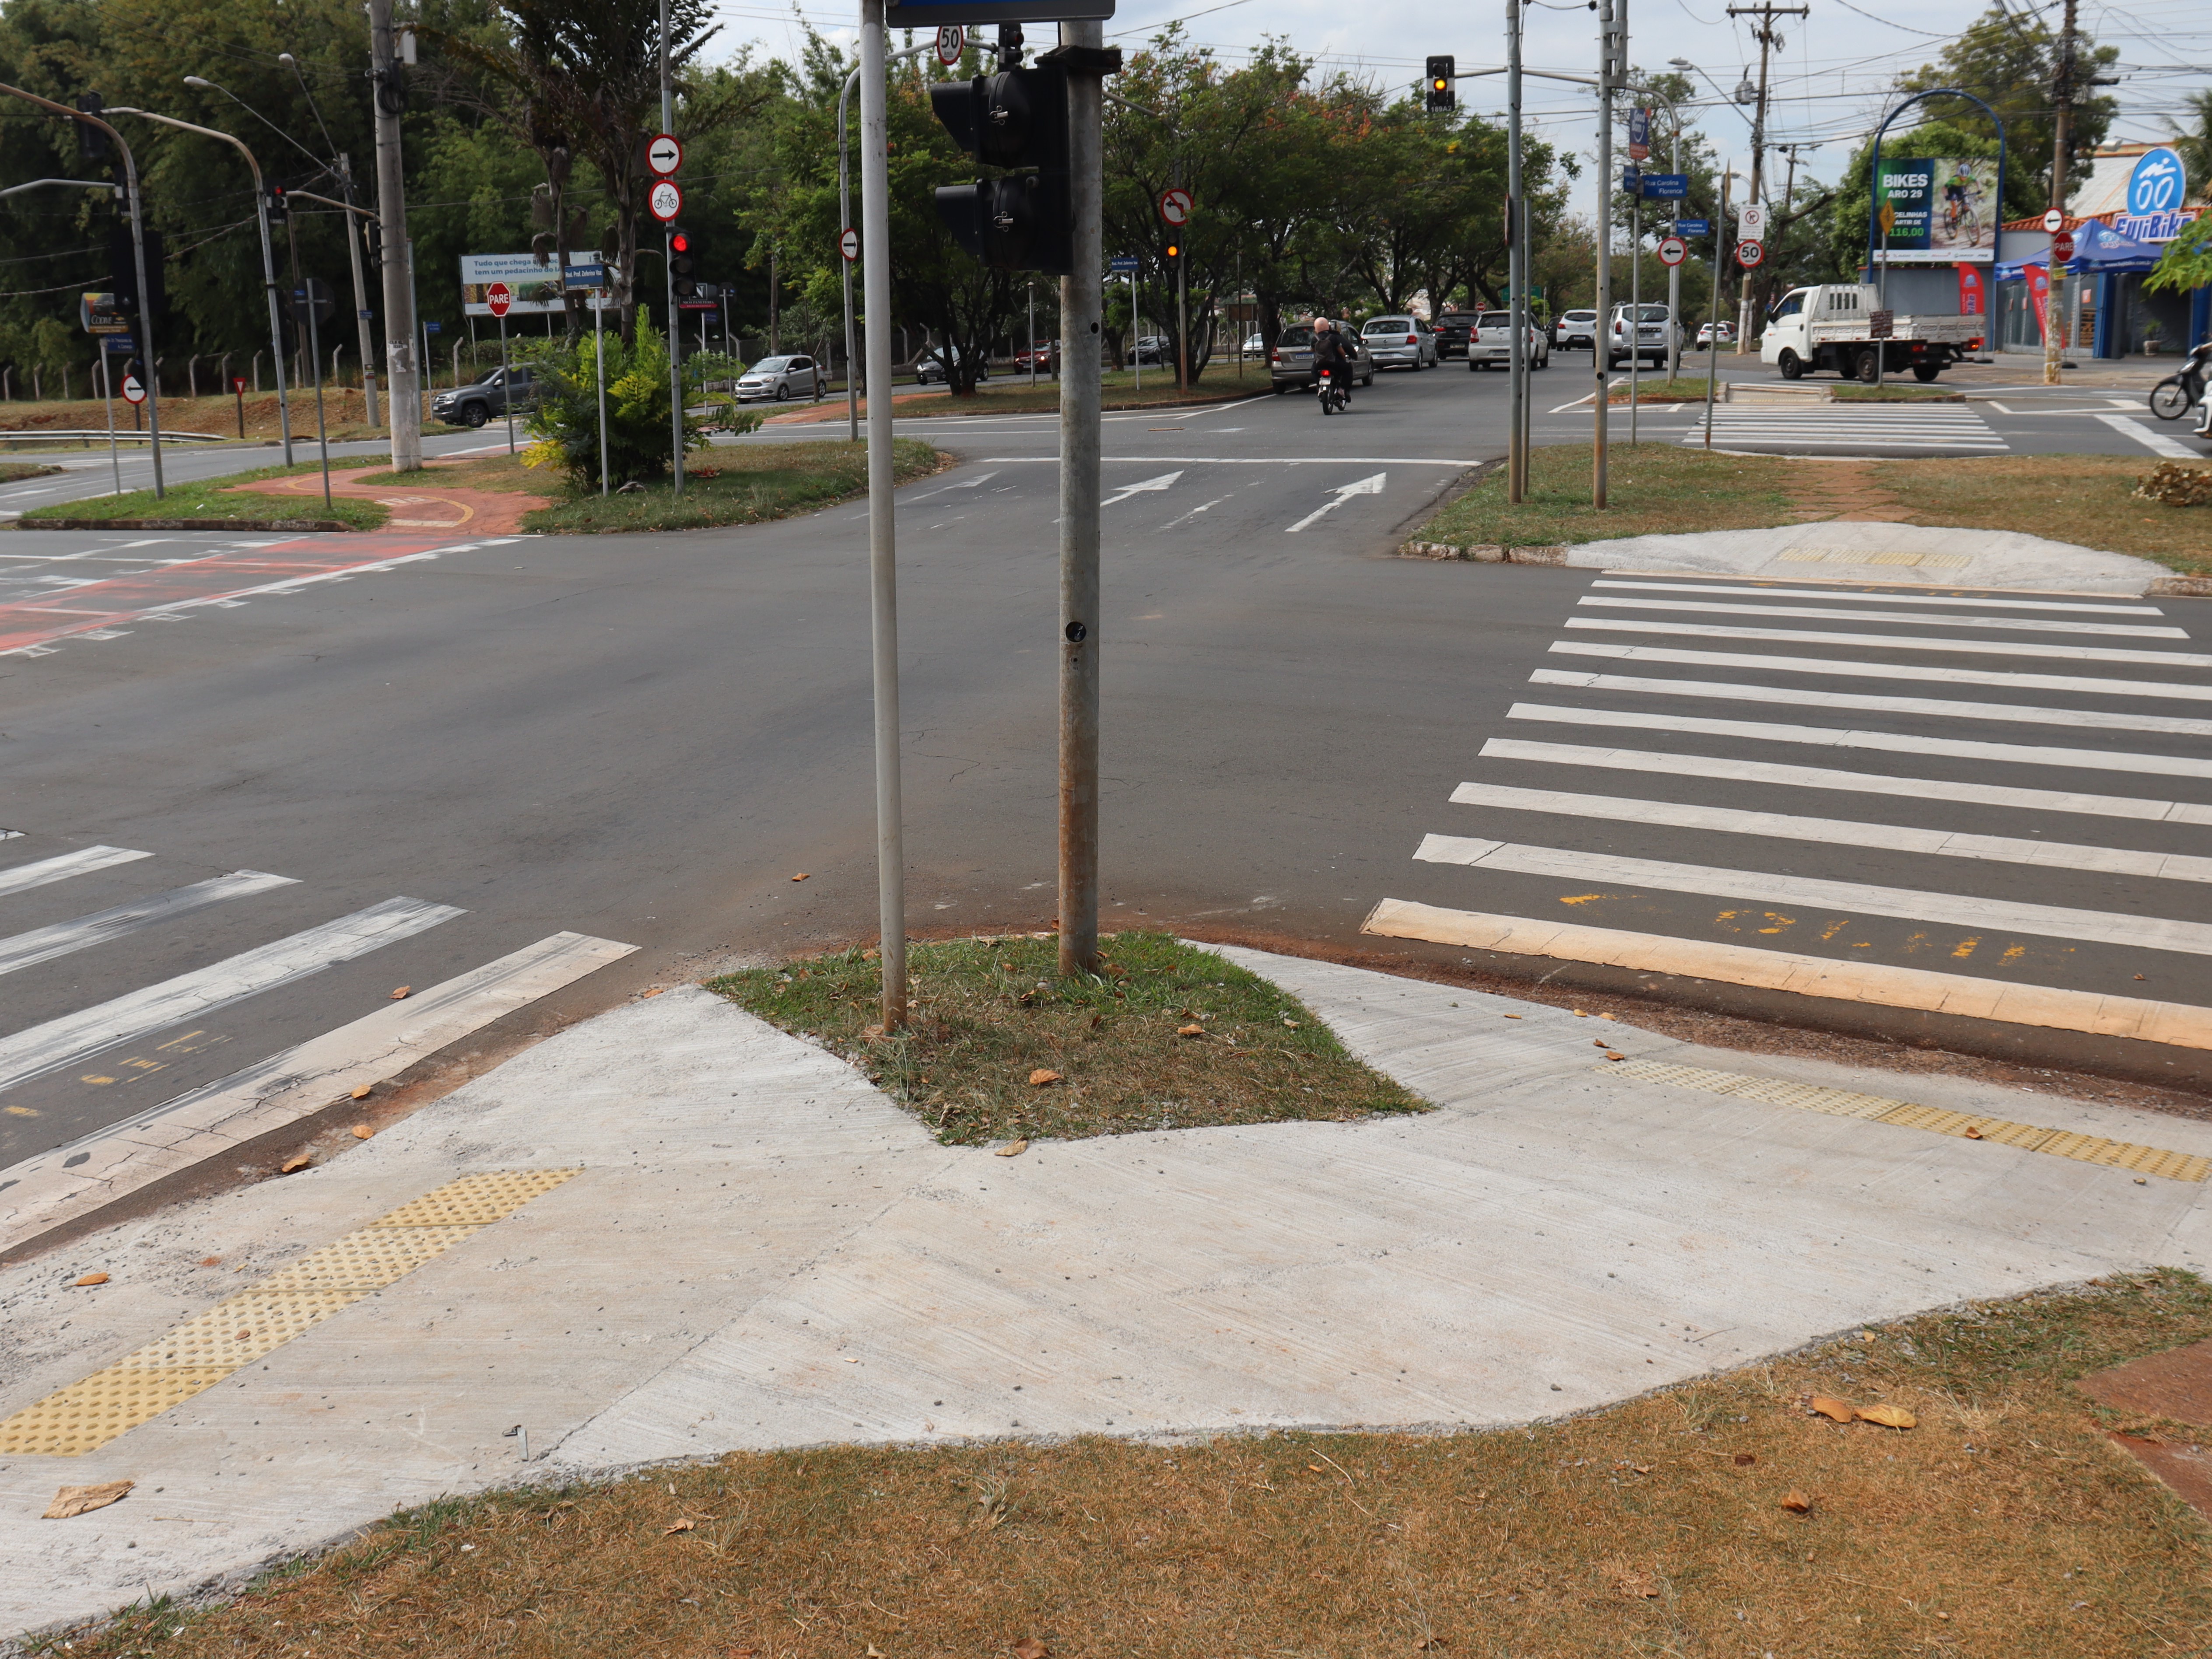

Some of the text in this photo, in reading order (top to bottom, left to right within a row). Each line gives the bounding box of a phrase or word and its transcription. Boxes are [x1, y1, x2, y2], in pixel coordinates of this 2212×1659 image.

[941, 28, 959, 49] 50
[1883, 174, 1928, 188] BIKES
[1887, 189, 1923, 198] ARO 29
[1742, 246, 1759, 258] 50
[2054, 242, 2073, 251] PARE
[505, 267, 543, 275] pedacinho
[489, 294, 509, 305] PARE
